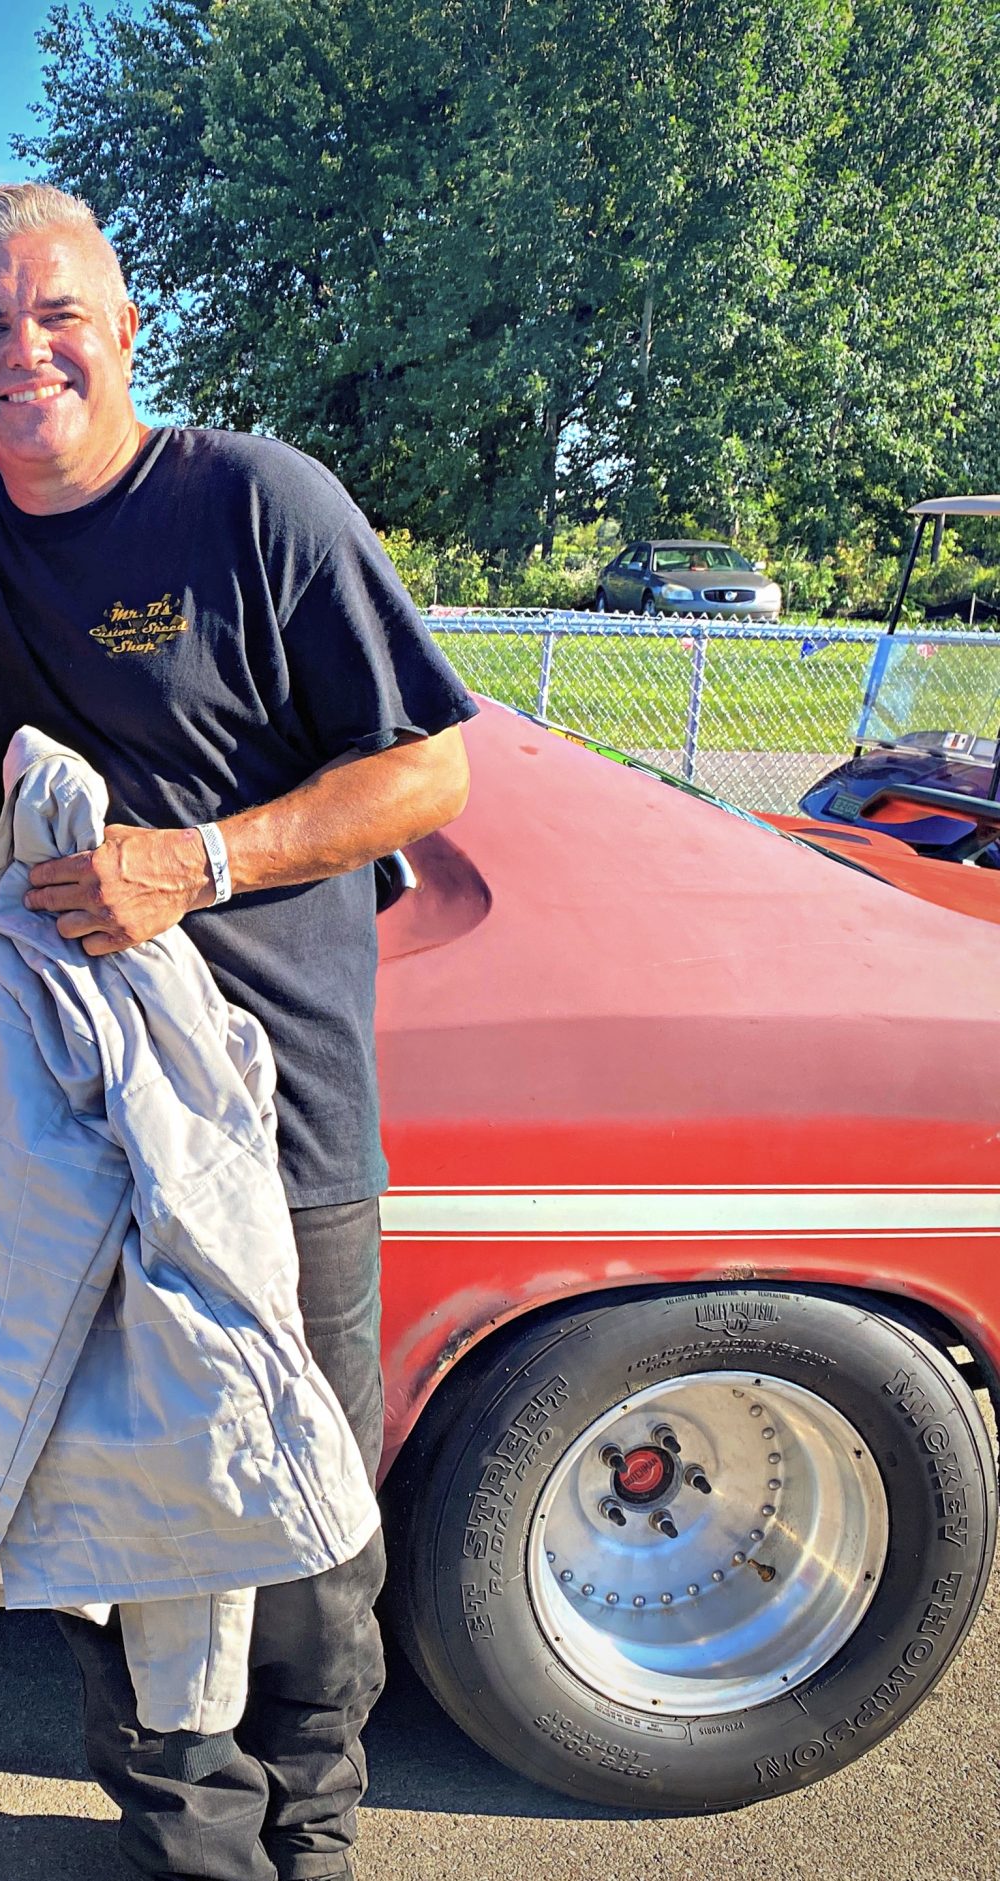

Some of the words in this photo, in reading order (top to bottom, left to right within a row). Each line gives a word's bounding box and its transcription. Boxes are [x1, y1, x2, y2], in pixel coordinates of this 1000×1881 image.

[89, 628, 136, 638] Custom
[142, 619, 188, 635] Speed
[111, 608, 143, 622] Mr.
[146, 601, 172, 617] B's
[112, 640, 157, 654] Shop
[463, 1374, 569, 1559] STREET
[489, 1488, 518, 1596] RADIAL
[515, 1427, 555, 1482] PRO
[882, 1368, 968, 1547] MICKEY
[461, 1582, 495, 1642] ET
[754, 1571, 963, 1784] THOMPSON
